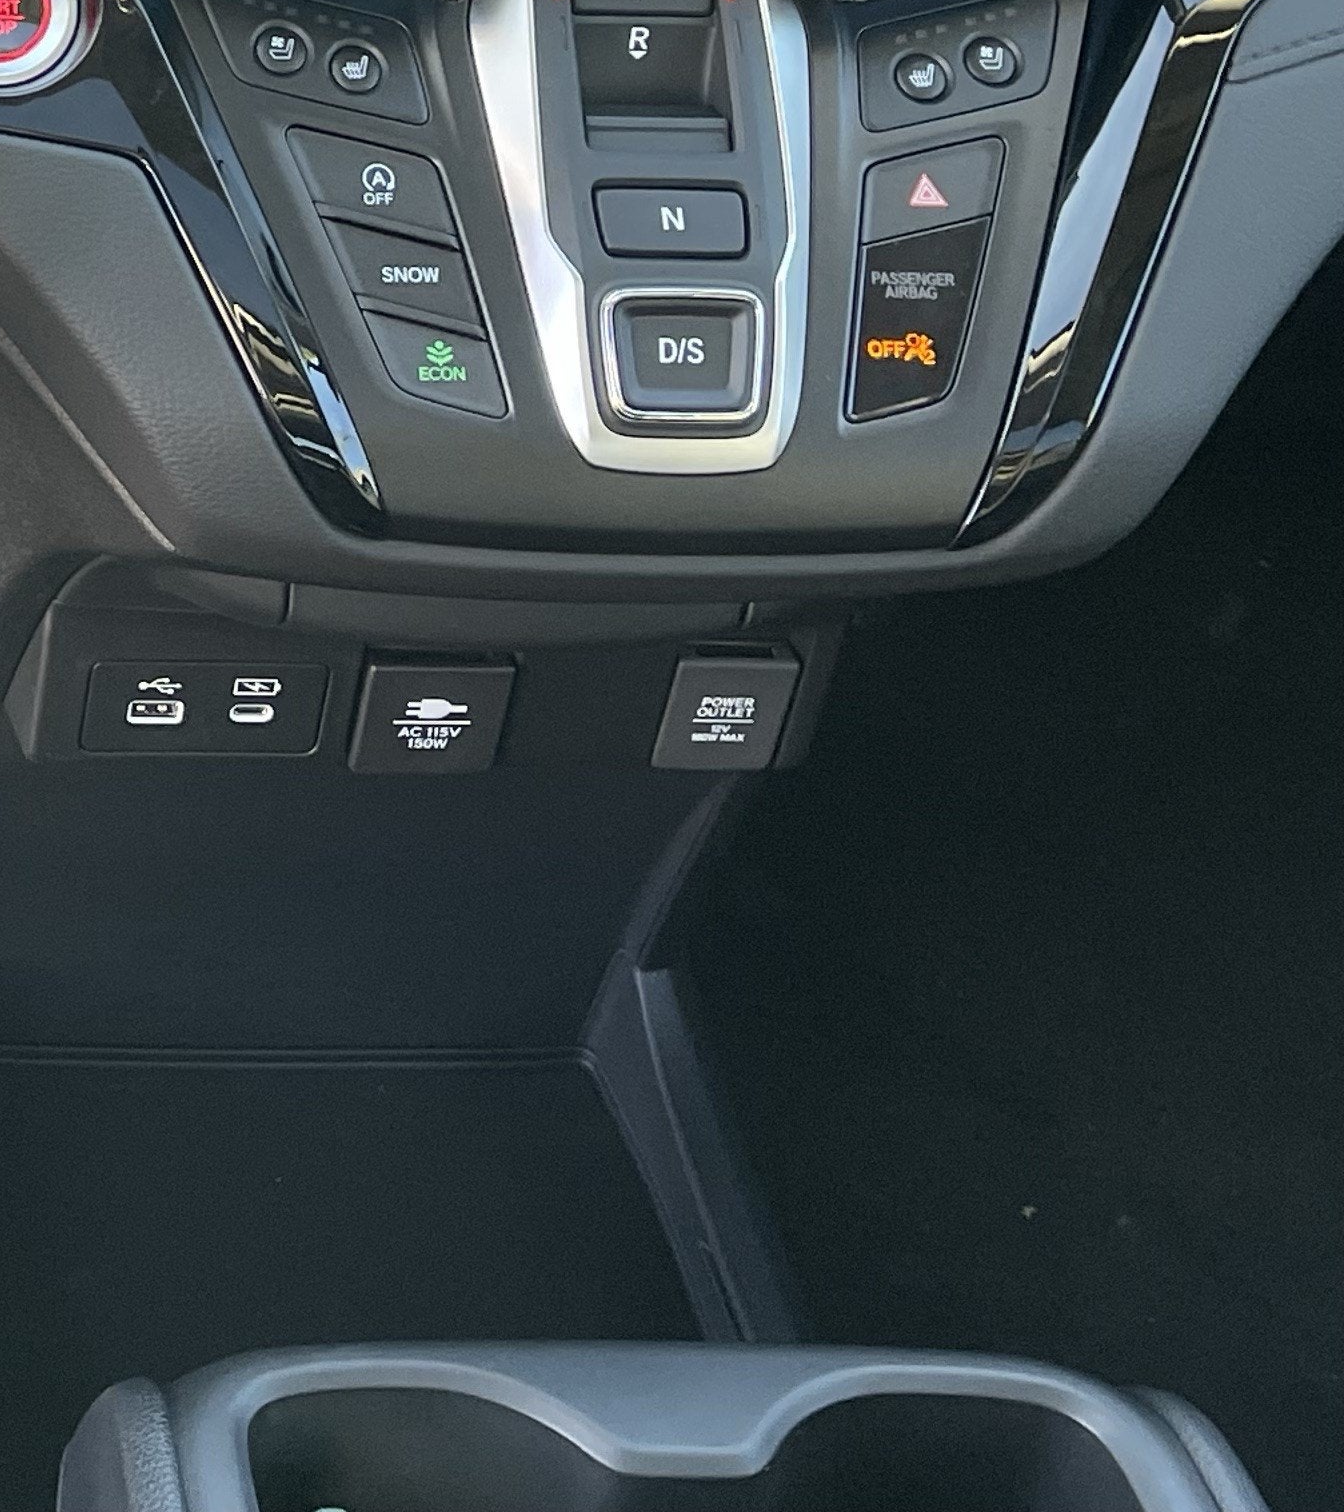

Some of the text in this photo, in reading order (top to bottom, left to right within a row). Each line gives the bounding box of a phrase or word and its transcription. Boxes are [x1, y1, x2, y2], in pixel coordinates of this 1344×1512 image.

[628, 26, 650, 52] R
[362, 191, 394, 206] OFF
[660, 206, 686, 231] N
[380, 266, 440, 284] SNOW
[871, 270, 956, 287] PASSENGER
[884, 285, 939, 300] AIRBAG
[658, 337, 705, 366] D/S
[867, 339, 906, 359] OFF
[418, 365, 467, 382] ECON
[700, 696, 756, 708] POWER
[696, 707, 756, 718] OUTLET
[397, 726, 462, 738] AC 115V
[407, 737, 449, 749] 150W
